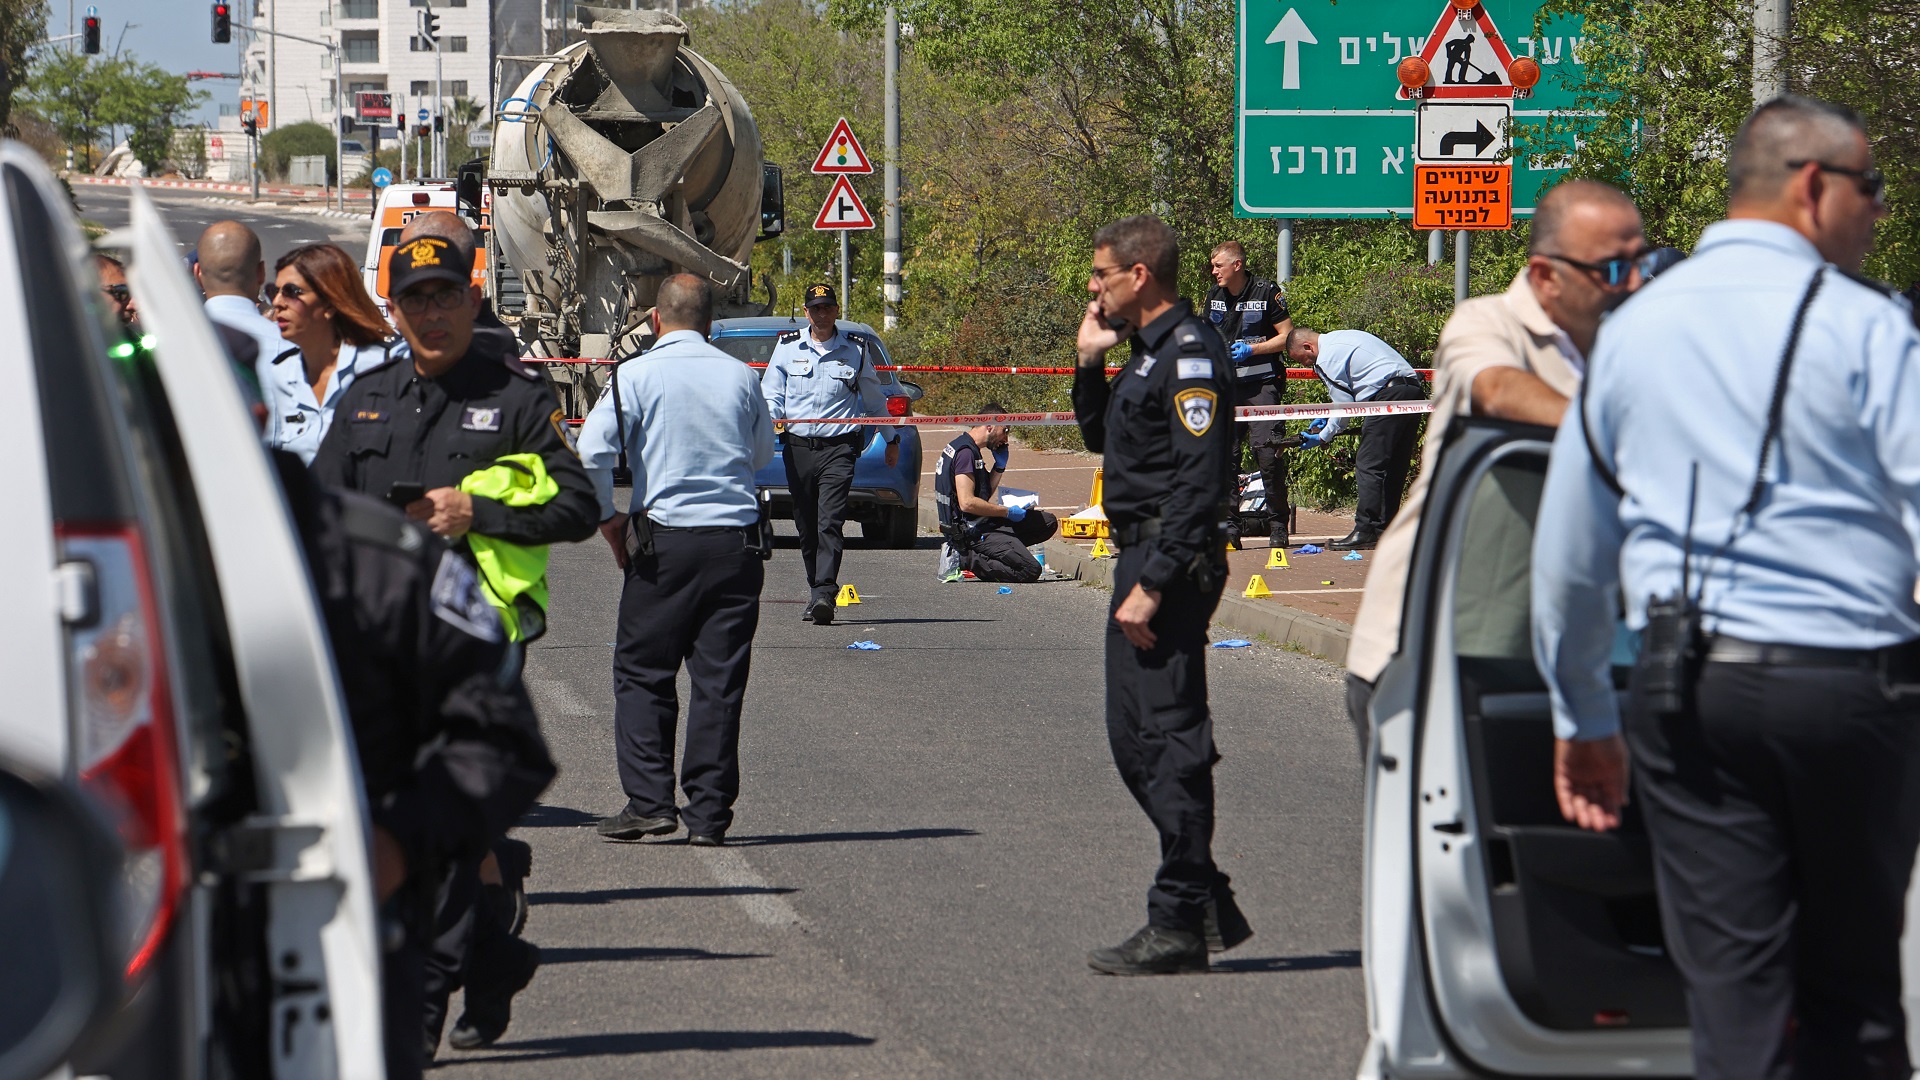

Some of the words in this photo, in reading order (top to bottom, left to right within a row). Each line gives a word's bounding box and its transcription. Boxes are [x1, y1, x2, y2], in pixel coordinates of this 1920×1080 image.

[1339, 32, 1425, 64] שלים
[1270, 146, 1356, 174] מרכז
[1425, 171, 1500, 184] שינויים
[1425, 190, 1500, 203] בתנועה
[1435, 207, 1490, 224] לפניך
[1276, 551, 1282, 562] 9
[1250, 578, 1256, 590] 8
[848, 588, 854, 599] 6
